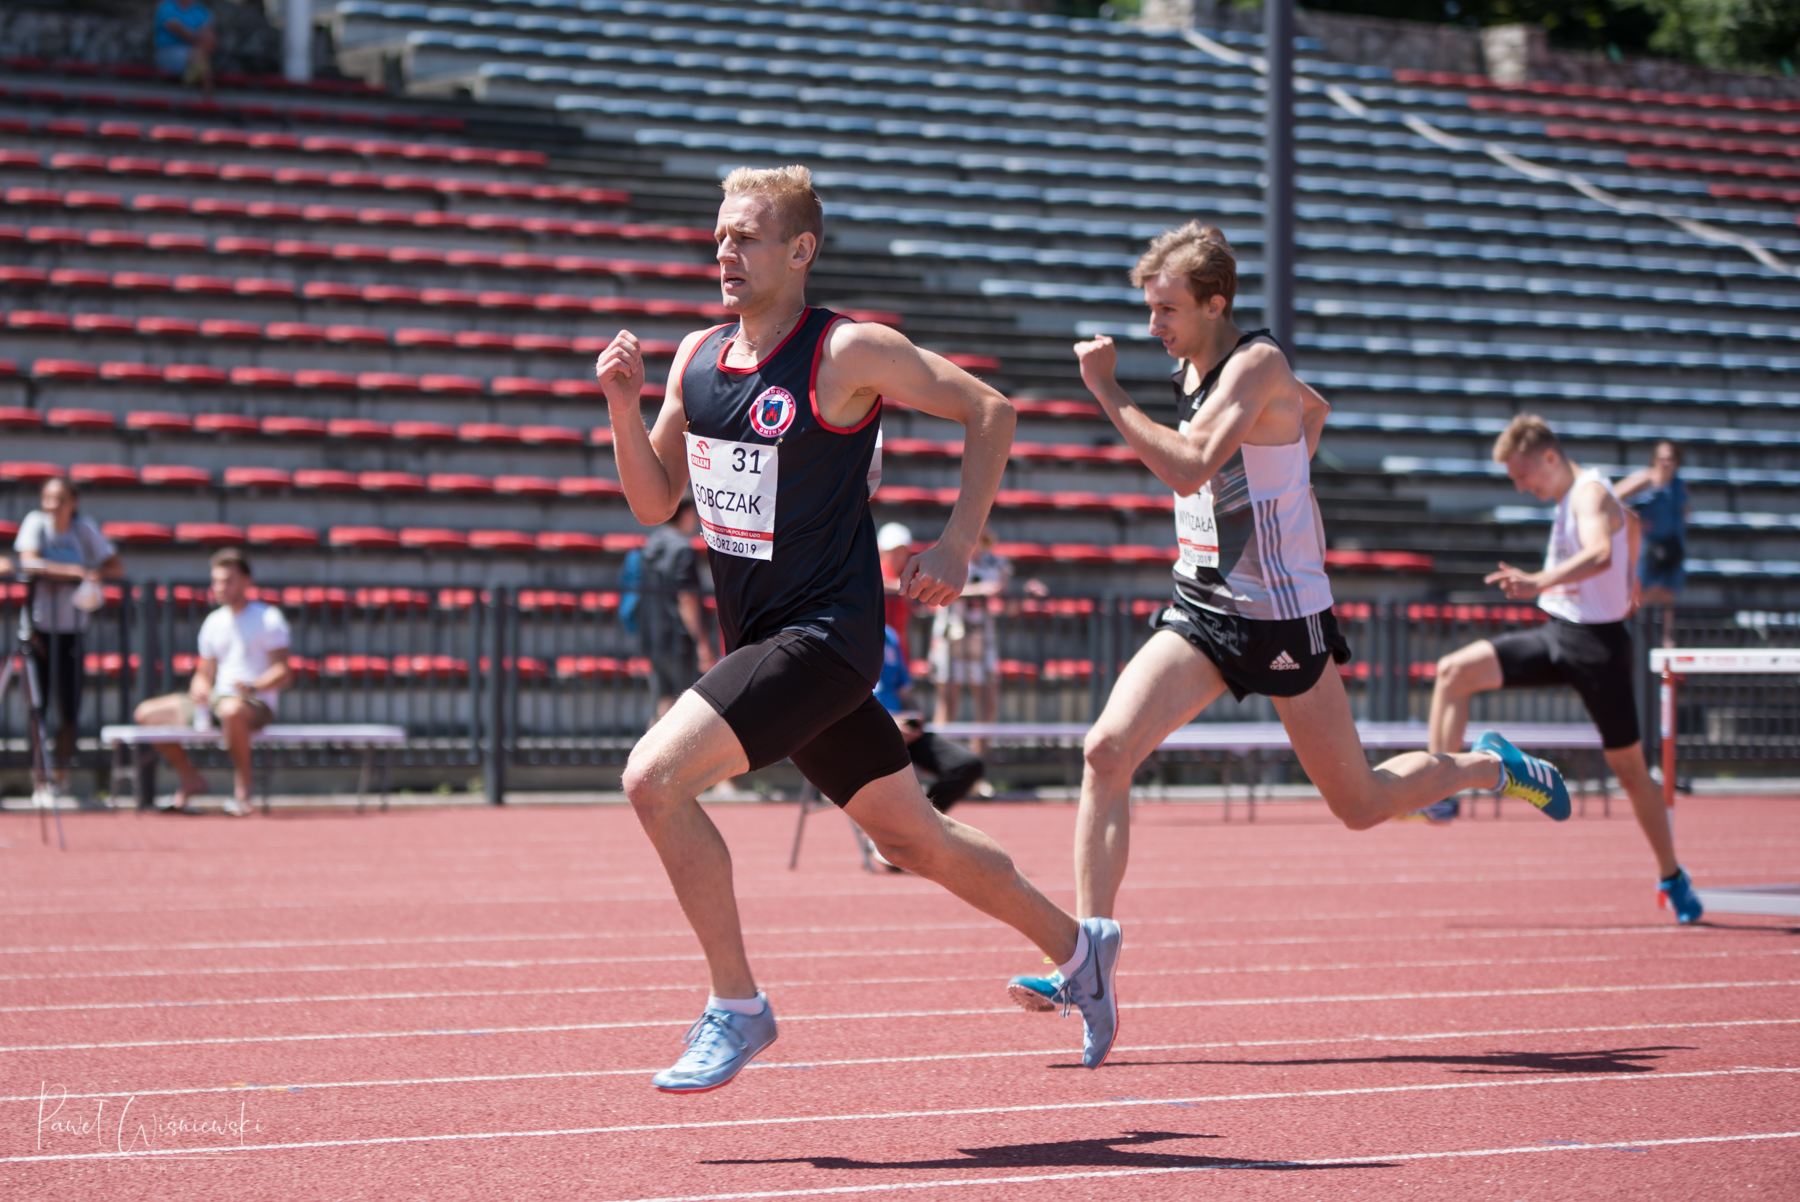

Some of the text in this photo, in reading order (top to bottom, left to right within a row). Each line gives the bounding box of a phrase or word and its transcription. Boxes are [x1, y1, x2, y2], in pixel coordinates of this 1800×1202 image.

[759, 427, 782, 435] GMINA
[691, 455, 710, 469] ORLEN
[732, 447, 761, 474] 31
[695, 483, 762, 515] SOBCZAK
[732, 541, 757, 555] 2019
[1197, 554, 1212, 565] 2019
[1269, 663, 1300, 671] adidas
